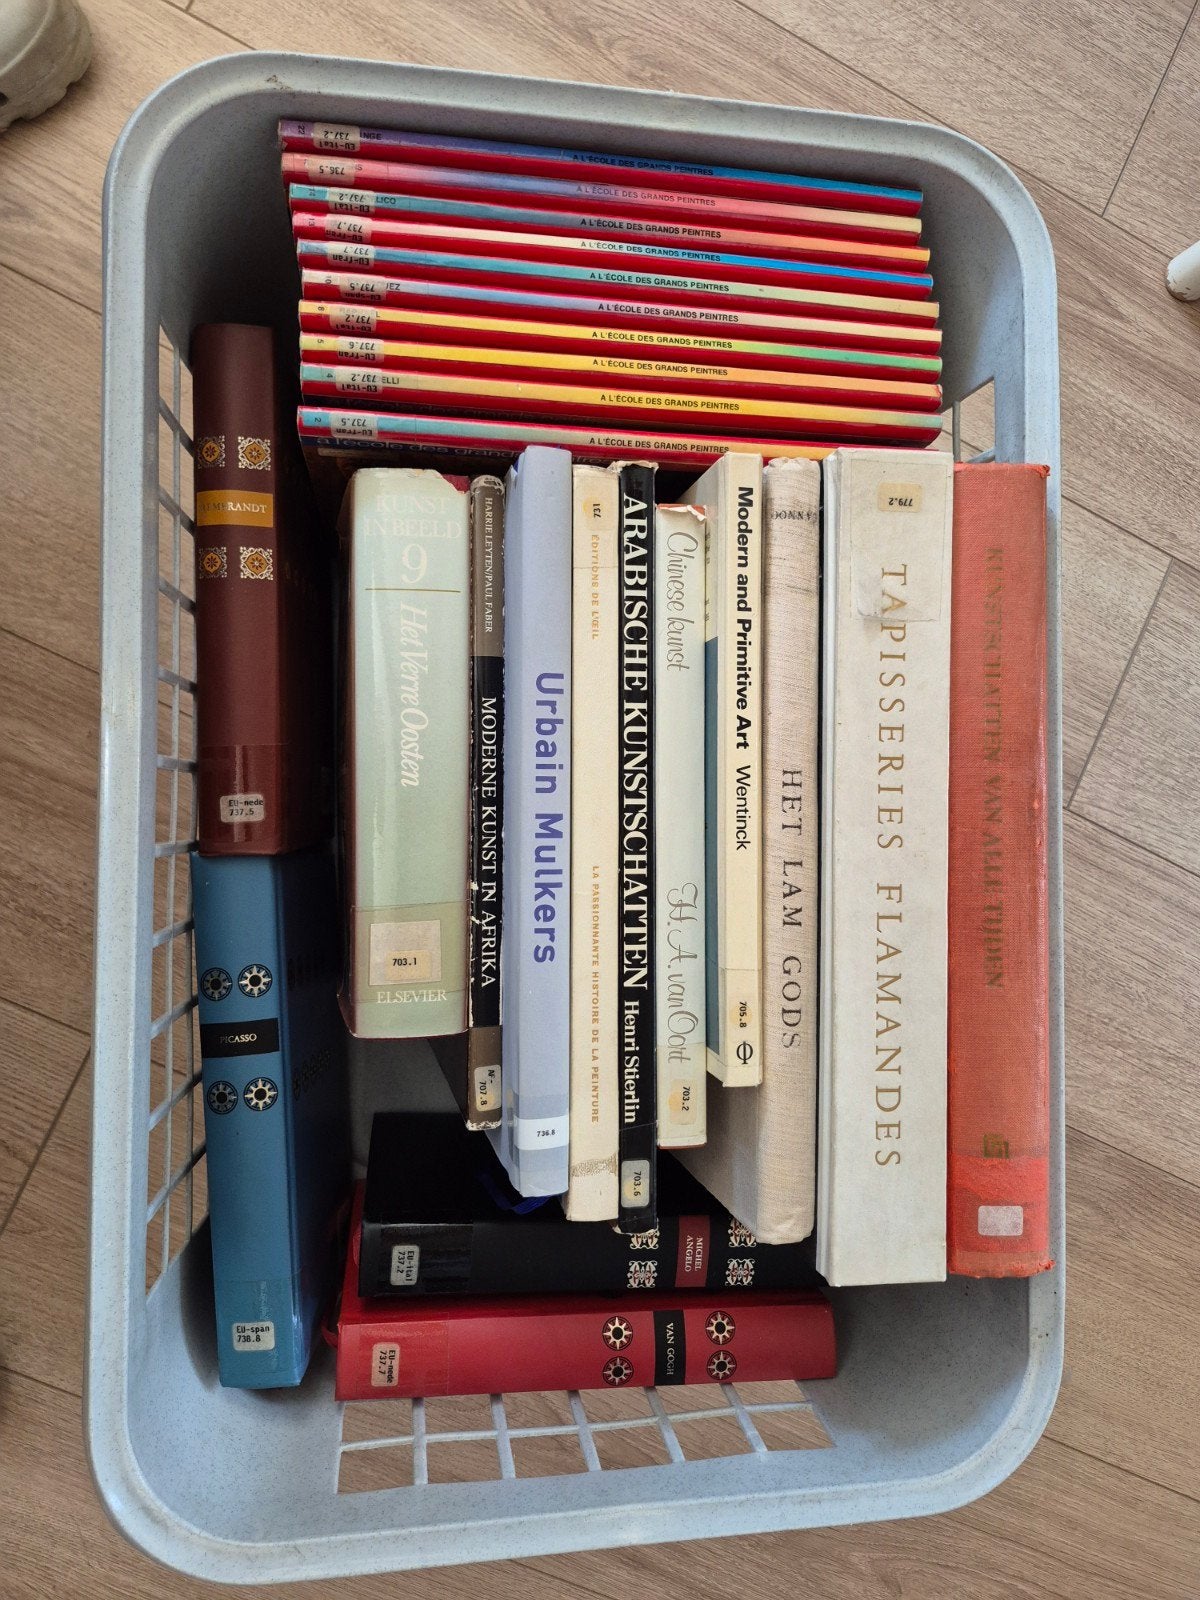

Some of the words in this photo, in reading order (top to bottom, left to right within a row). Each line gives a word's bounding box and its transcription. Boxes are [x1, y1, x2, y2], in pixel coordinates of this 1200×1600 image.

[319, 141, 355, 150] EU-ital
[323, 131, 349, 140] 737.2
[319, 165, 345, 175] 736.5
[638, 161, 671, 171] GRANDS
[674, 165, 713, 175] PEINTRES
[334, 203, 370, 212] EU-ital
[339, 193, 364, 202] 737.2
[641, 193, 674, 202] GRANDS
[678, 196, 716, 206] PEINTRES
[337, 222, 363, 233] 737.7
[627, 223, 642, 231] DES
[645, 225, 679, 234] GRANDS
[682, 228, 721, 238] PEINTRES
[332, 255, 369, 265] EU-fran
[343, 246, 369, 255] 737.7
[645, 247, 679, 257] GRANDS
[682, 251, 720, 261] PEINTRES
[350, 282, 375, 291] 737.5
[636, 276, 652, 284] DES
[654, 278, 688, 287] GRANDS
[691, 282, 729, 291] PEINTRES
[345, 314, 371, 323] 737.2
[663, 309, 697, 319] GRANDS
[700, 313, 738, 322] PEINTRES
[349, 342, 375, 350] 737.6
[657, 336, 690, 345] GRANDS
[694, 340, 732, 349] PEINTRES
[338, 351, 376, 360] EU-fran
[351, 374, 376, 382] 737.2
[655, 364, 688, 373] GRANDS
[691, 367, 728, 376] PEINTRES
[341, 384, 377, 392] EU-ital
[665, 399, 698, 408] GRANDS
[701, 402, 739, 411] PEINTRES
[341, 418, 366, 427] 737.5
[635, 441, 650, 449] DES
[653, 442, 687, 451] GRANDS
[690, 445, 729, 453] PEINTRES
[201, 502, 267, 513] REMRANDT
[593, 503, 602, 518] 731
[888, 496, 914, 506] 779.2
[484, 497, 493, 534] HARRIE
[737, 486, 754, 568] Modern
[401, 543, 428, 584] 9
[666, 531, 699, 611] Chinese
[591, 593, 600, 606] DE
[623, 492, 649, 690] ARABISCHE
[736, 573, 752, 612] and
[400, 603, 428, 647] Het
[484, 601, 493, 633] FABER
[666, 617, 695, 671] kunst
[736, 618, 752, 710] Primitive
[400, 651, 429, 706] Verre
[877, 564, 908, 849] TAPISSERIES
[535, 672, 565, 794] Urbain
[736, 716, 752, 750] Art
[400, 707, 429, 787] Oosten
[481, 697, 497, 798] MODERNE
[229, 798, 263, 806] EU-nede
[736, 765, 751, 850] Wentinck
[781, 770, 802, 837] HET
[982, 772, 1003, 824] VAN
[230, 808, 254, 816] 737.5
[481, 806, 497, 874] KUNST
[623, 701, 648, 990] KUNSTSCHATTEN
[592, 865, 600, 879] LA
[481, 881, 497, 902] IN
[534, 813, 564, 963] Mulkers
[782, 860, 803, 928] LAM
[592, 883, 600, 967] PASSIONNANTE
[481, 910, 497, 988] AFRIKA
[392, 958, 417, 967] 703.1
[377, 989, 448, 1004] ELSEVIER
[592, 972, 600, 1024] HISTOIRE
[667, 973, 687, 1009] van
[781, 955, 802, 1049] GODS
[624, 1000, 640, 1052] Henri
[739, 1001, 747, 1028] 705.8
[875, 883, 903, 1166] FLAMANDES
[219, 1033, 257, 1043] PICASSO
[592, 1030, 599, 1044] DE
[667, 1010, 699, 1064] Oort
[592, 1048, 599, 1062] LA
[479, 1080, 488, 1106] 707.8
[591, 1066, 599, 1123] PEINTURE
[624, 1055, 640, 1124] Stierlin
[682, 1086, 690, 1112] 703.2
[537, 1128, 556, 1138] 736.8
[633, 1170, 642, 1197] 703.6
[396, 1251, 406, 1274] 737.2
[404, 1250, 415, 1282] EU-ital
[694, 1237, 704, 1272] MICHEL
[236, 1325, 270, 1334] EU-span
[666, 1322, 674, 1344] VAN
[378, 1350, 387, 1375] 737.7
[385, 1350, 396, 1384] EU-nede
[666, 1348, 675, 1376] GOGH
